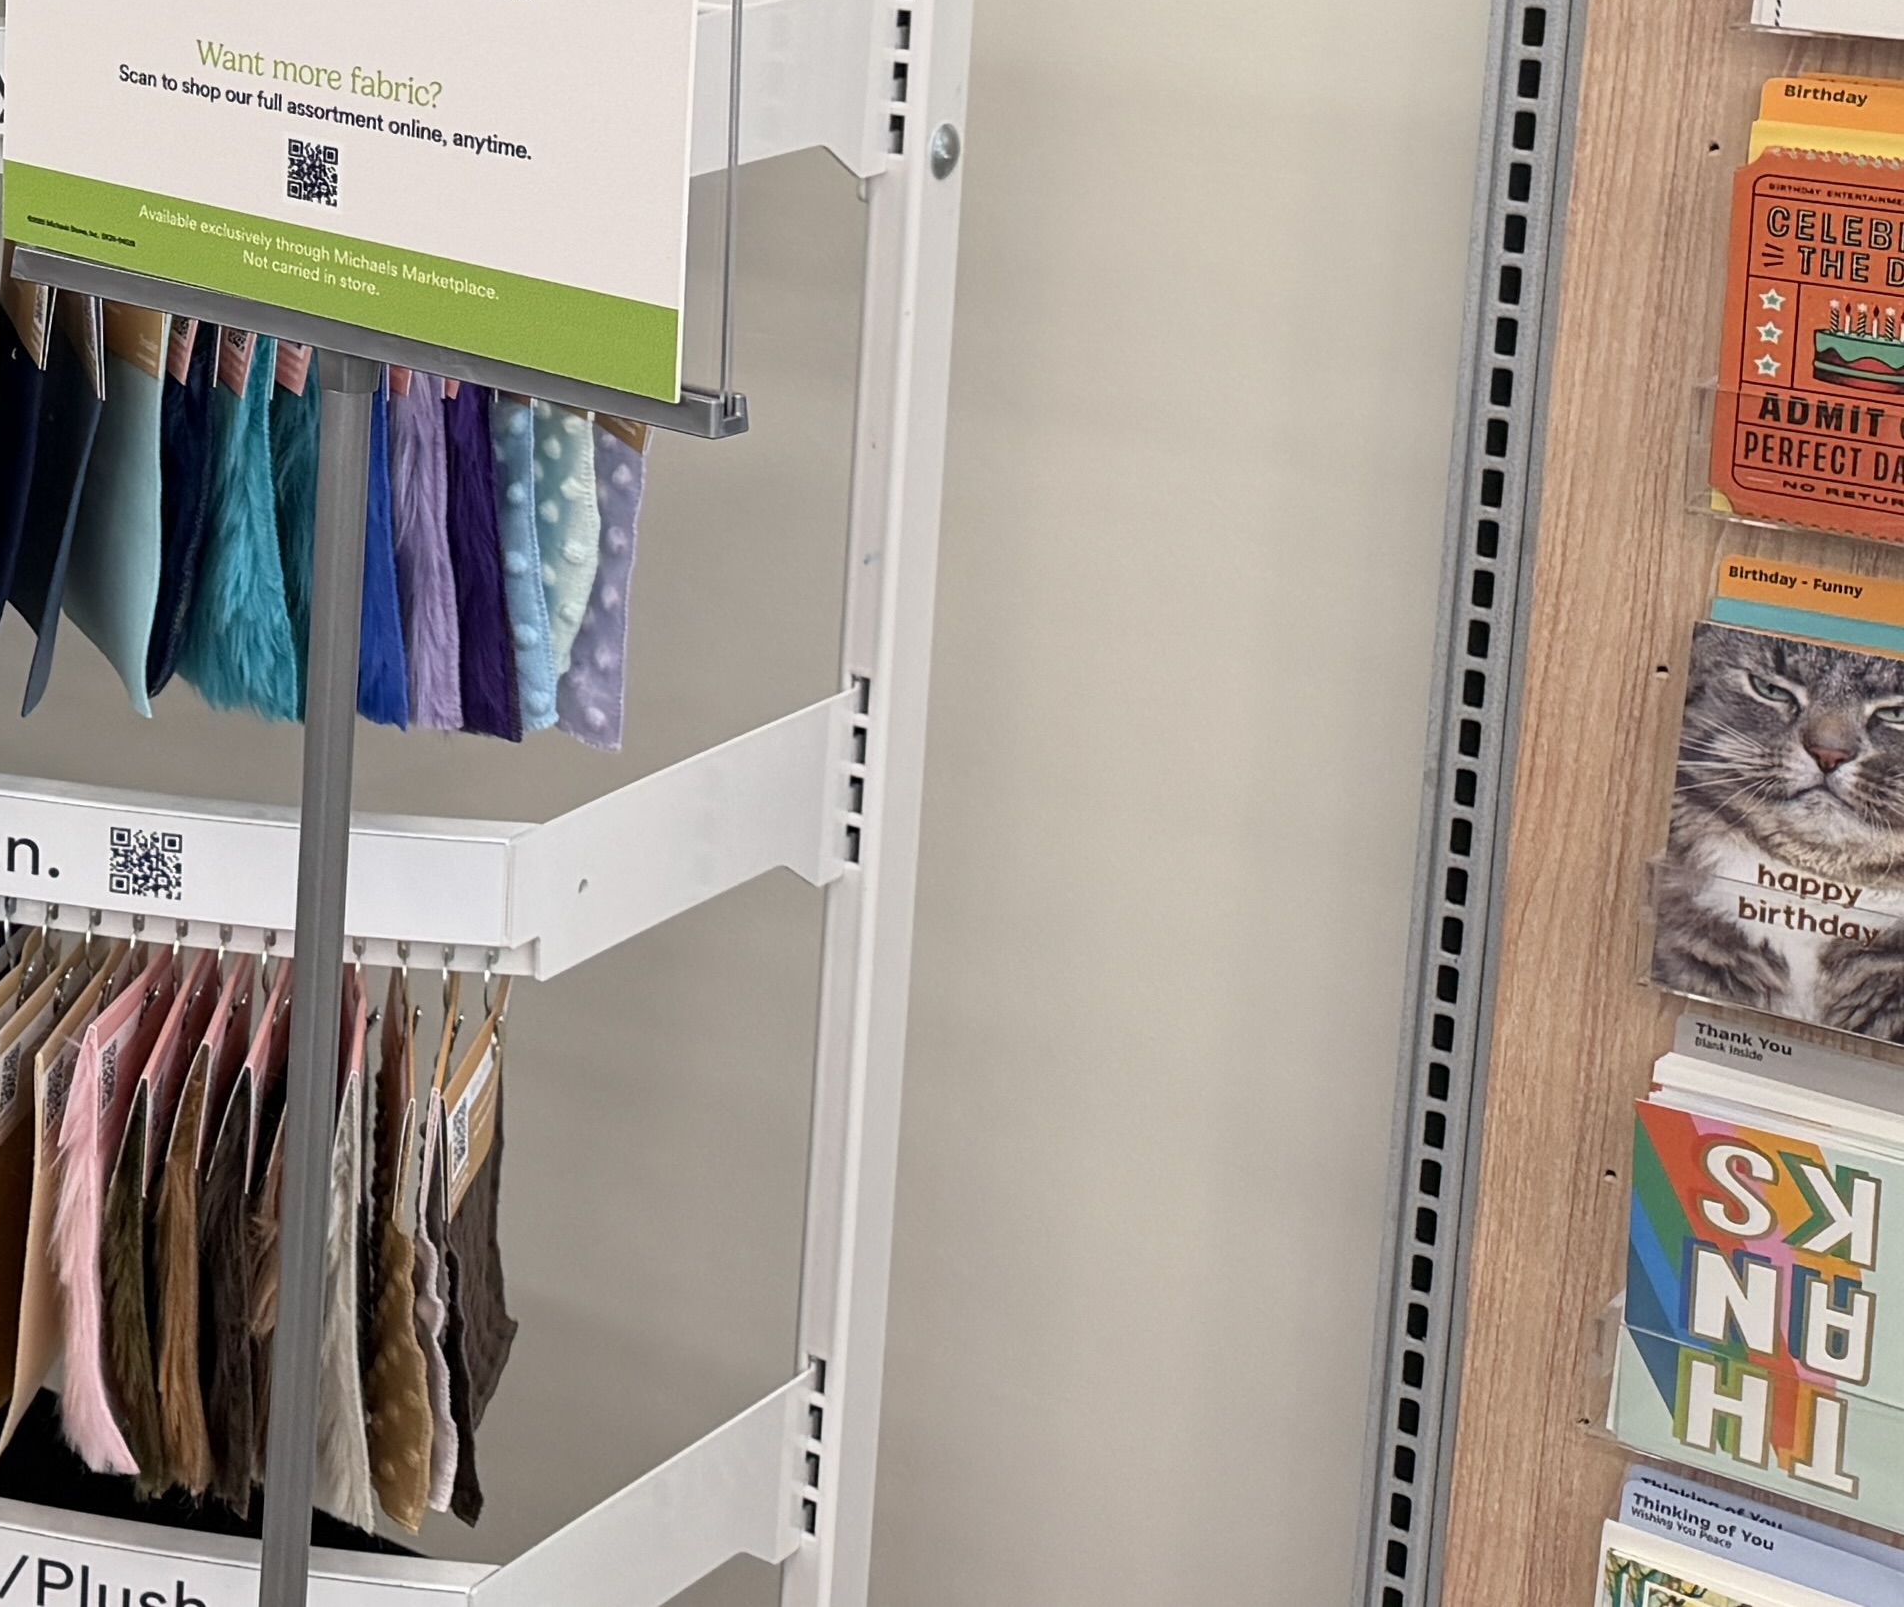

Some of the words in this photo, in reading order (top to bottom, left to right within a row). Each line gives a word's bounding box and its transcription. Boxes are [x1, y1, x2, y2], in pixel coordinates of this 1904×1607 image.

[195, 38, 265, 77] Want
[272, 59, 342, 91] more
[350, 65, 443, 109] fabric?
[1784, 84, 1868, 108] Birthday
[119, 63, 157, 88] Scan
[181, 76, 222, 103] shop
[225, 89, 253, 106] our
[256, 90, 283, 112] full
[286, 101, 384, 132] assortment
[388, 118, 448, 147] online,
[452, 132, 532, 161] anytime.
[138, 204, 198, 231] Available
[200, 221, 273, 251] exclusively
[275, 236, 330, 263] through
[334, 247, 398, 278] Michaels
[402, 263, 500, 301] Marketplace.
[242, 249, 268, 270] Not
[271, 260, 320, 282] carried
[339, 276, 380, 296] store.
[1798, 245, 1871, 284] THE
[1757, 391, 1885, 438] ADMIT
[1742, 433, 1864, 478] PERFECT
[1728, 565, 1798, 589] Birthday
[1813, 577, 1863, 599] Funny
[1757, 863, 1865, 908] happy
[1737, 896, 1881, 948] birthday
[1694, 1037, 1726, 1053] Blank
[1729, 1044, 1764, 1062] Inside
[1695, 1022, 1753, 1047] Thank
[1758, 1036, 1792, 1056] You
[1631, 1492, 1712, 1530] Thinking
[1716, 1522, 1738, 1539] of
[1740, 1528, 1777, 1552] You
